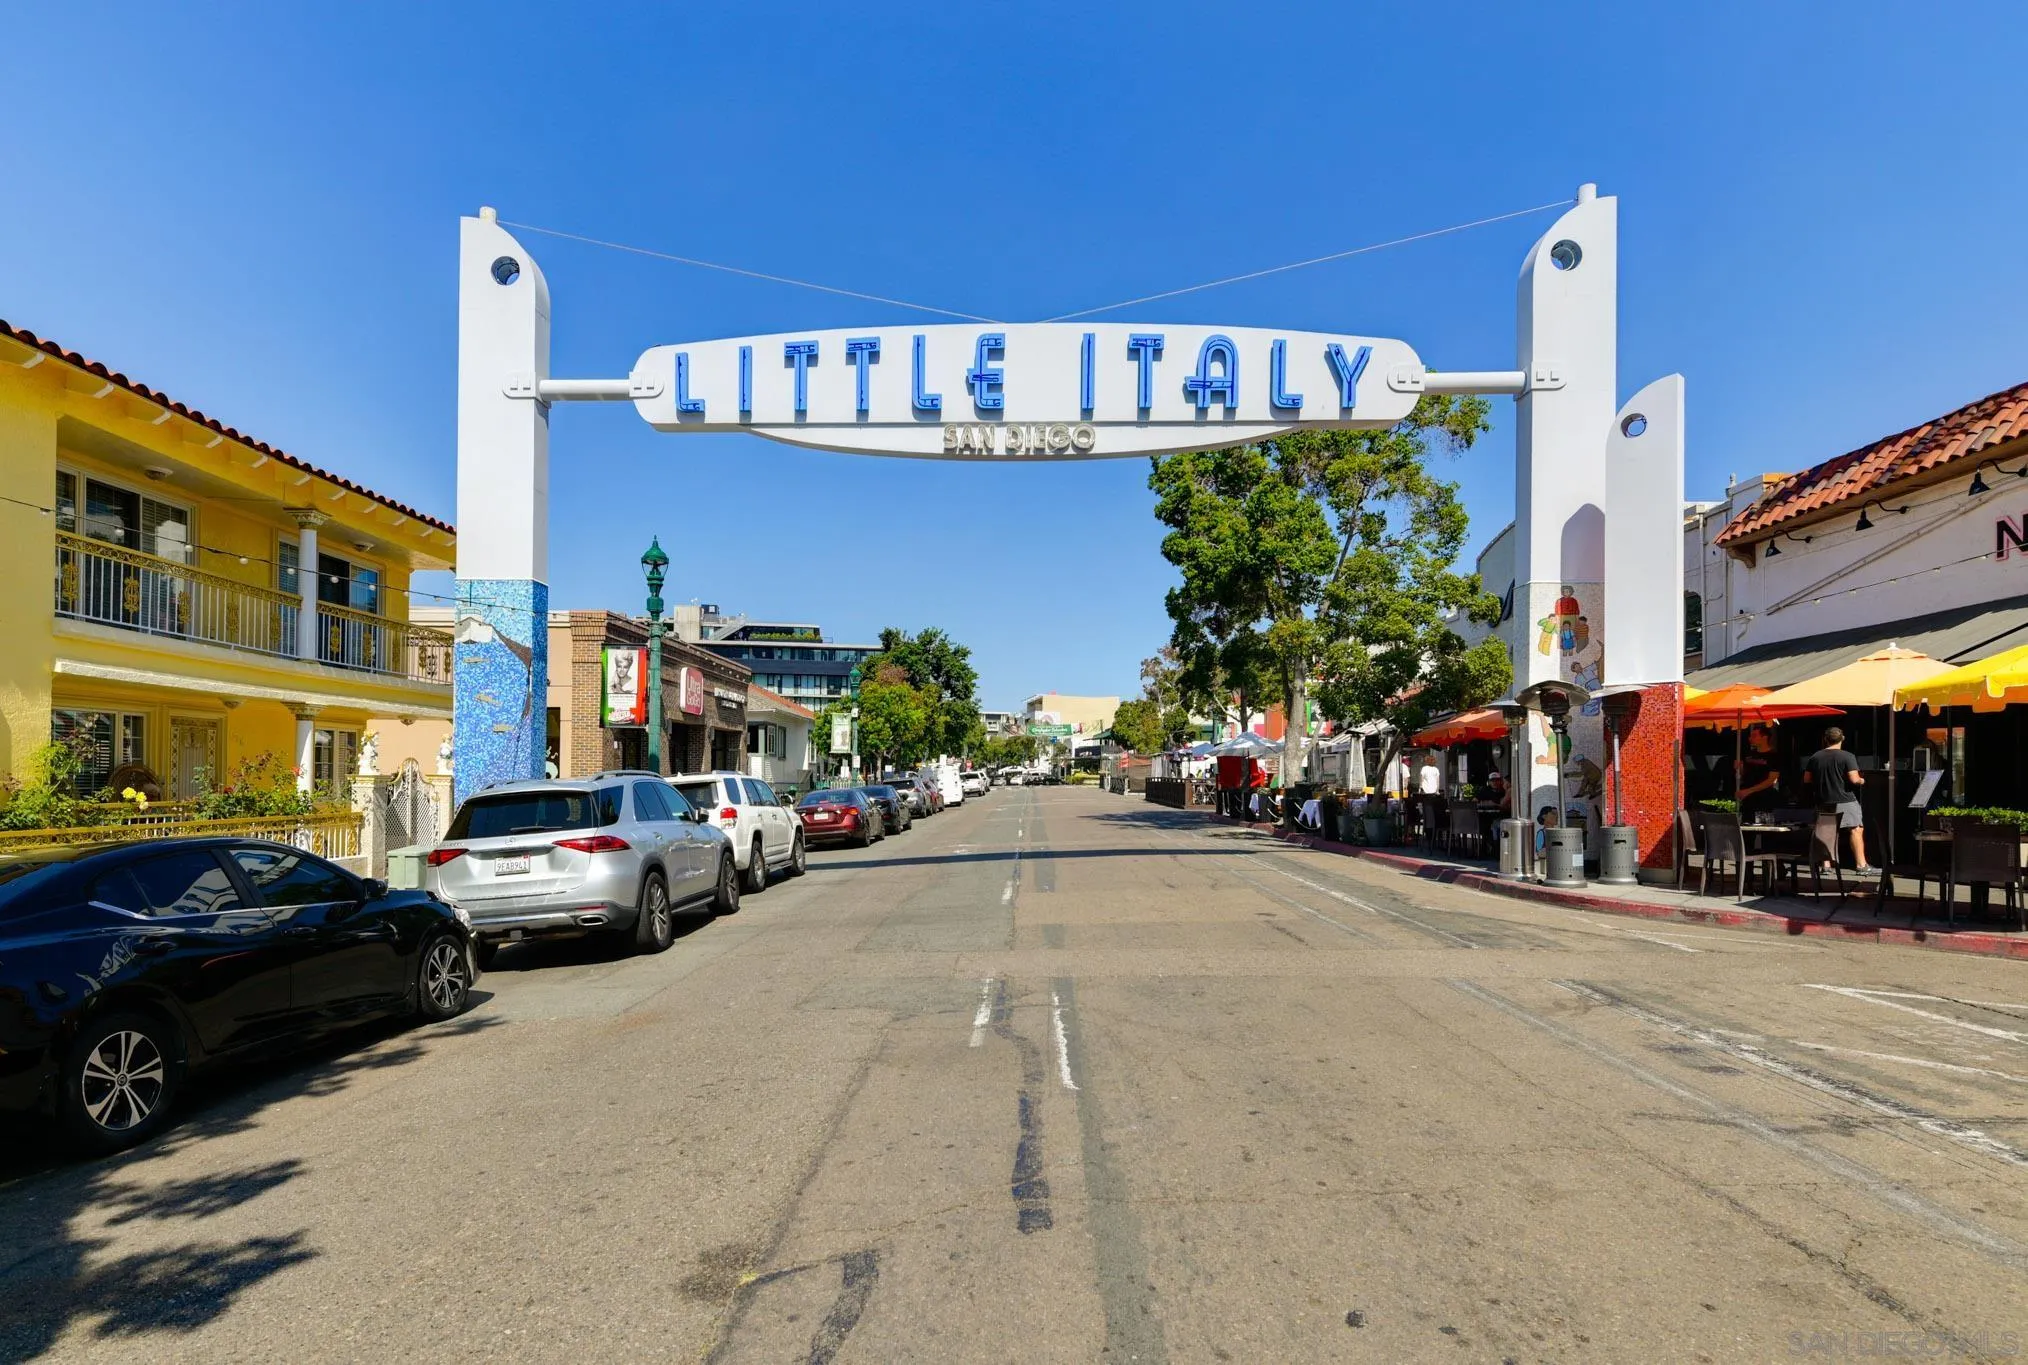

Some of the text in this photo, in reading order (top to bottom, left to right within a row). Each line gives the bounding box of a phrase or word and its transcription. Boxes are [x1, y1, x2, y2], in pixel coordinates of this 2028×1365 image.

[674, 332, 1374, 413] LITTLE ITALY
[943, 422, 1096, 451] SAN DIEGO
